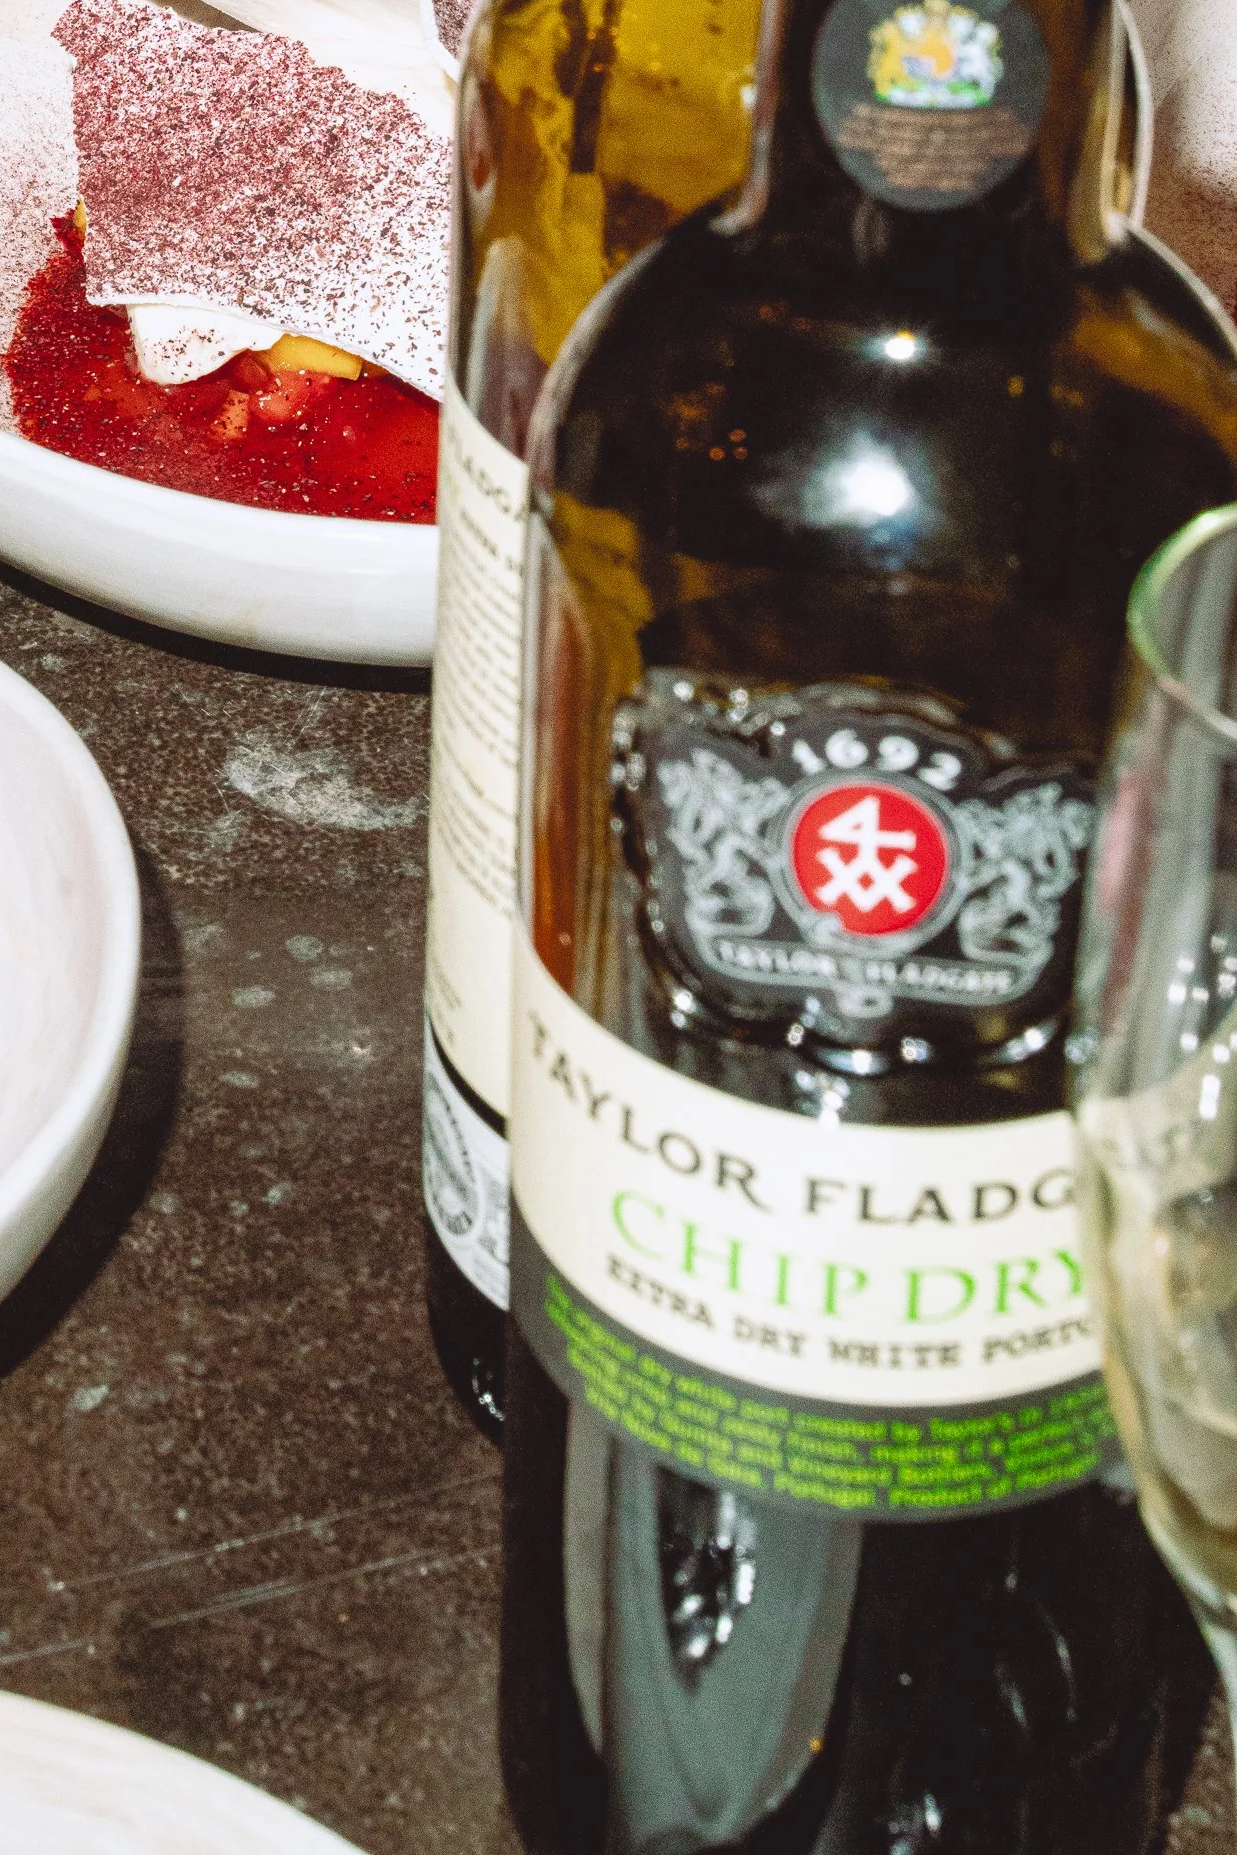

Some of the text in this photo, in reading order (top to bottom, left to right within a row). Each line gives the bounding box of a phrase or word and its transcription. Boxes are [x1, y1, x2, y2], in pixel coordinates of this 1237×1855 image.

[791, 728, 963, 792] 1692
[528, 1010, 773, 1215] TAYLOR
[607, 1254, 715, 1331] EXTRA
[731, 1313, 808, 1358] DRY
[828, 1335, 962, 1371] WHITE
[610, 1188, 870, 1317] CHIP
[902, 1247, 1085, 1326] DRY
